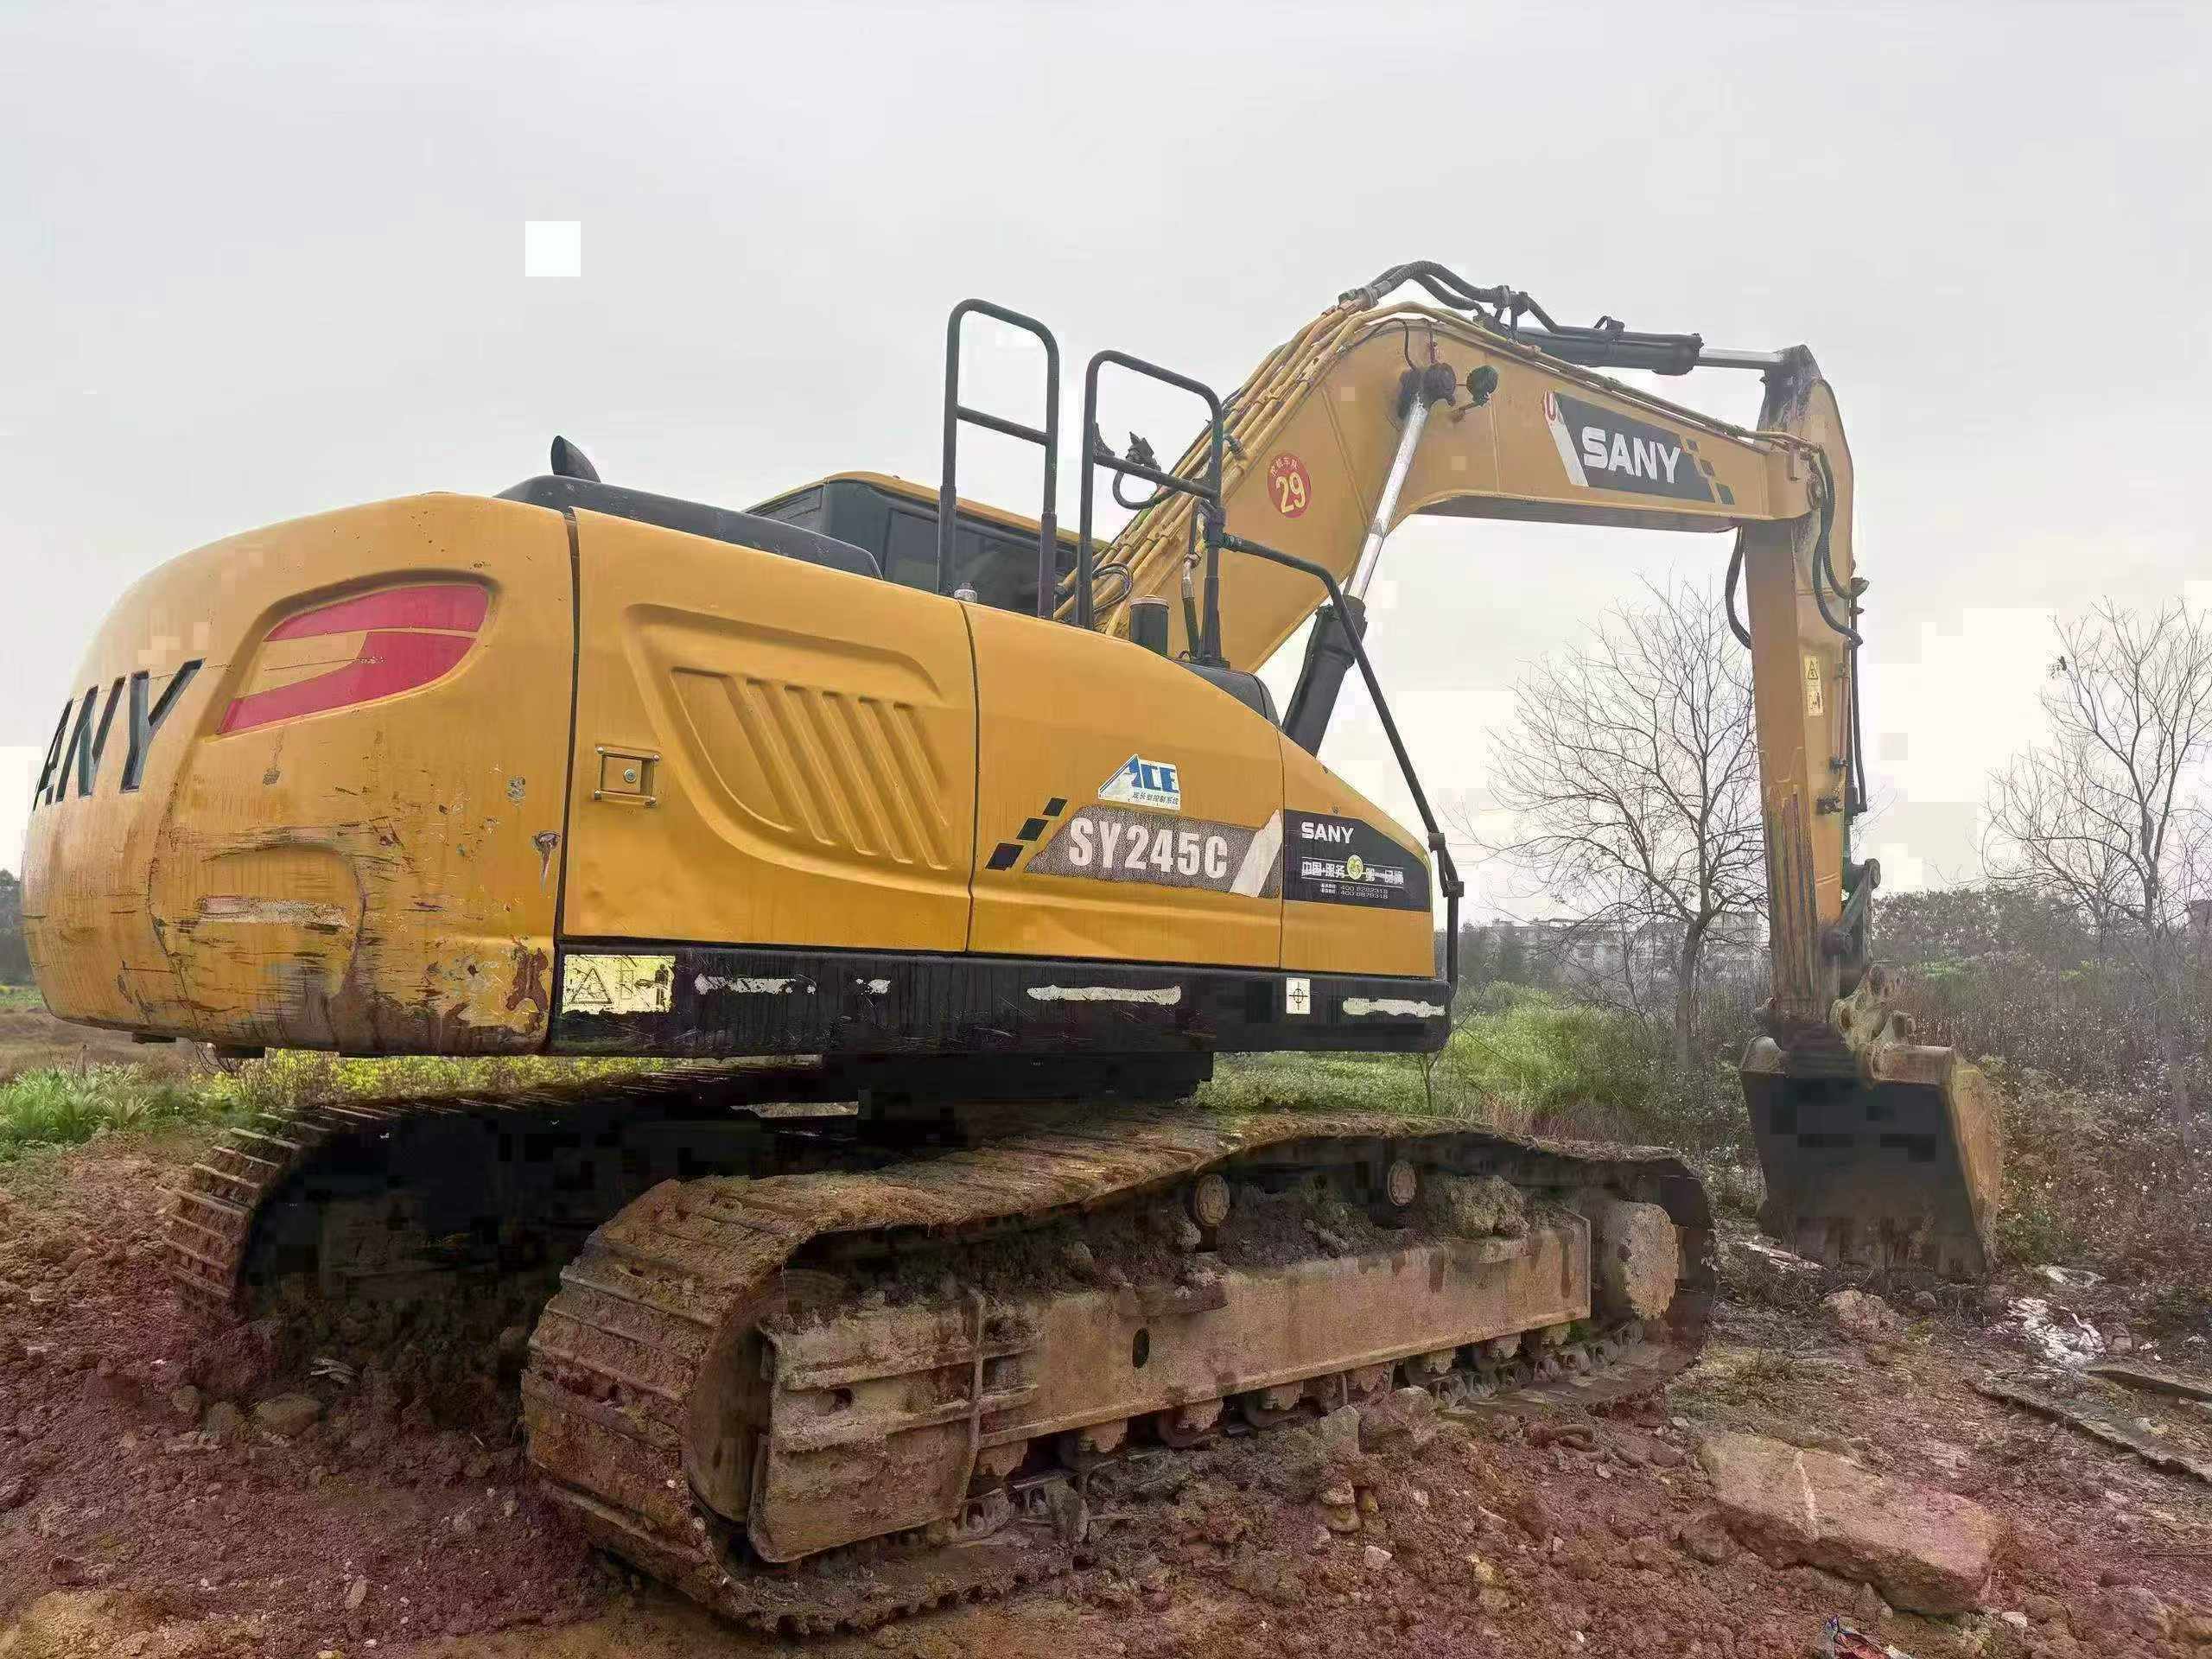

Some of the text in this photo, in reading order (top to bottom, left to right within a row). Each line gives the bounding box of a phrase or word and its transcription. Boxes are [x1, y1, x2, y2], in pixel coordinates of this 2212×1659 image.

[1582, 426, 1681, 484] SANY
[1276, 471, 1306, 513] 29
[1069, 817, 1228, 879] SY245C
[1301, 822, 1354, 843] SANY
